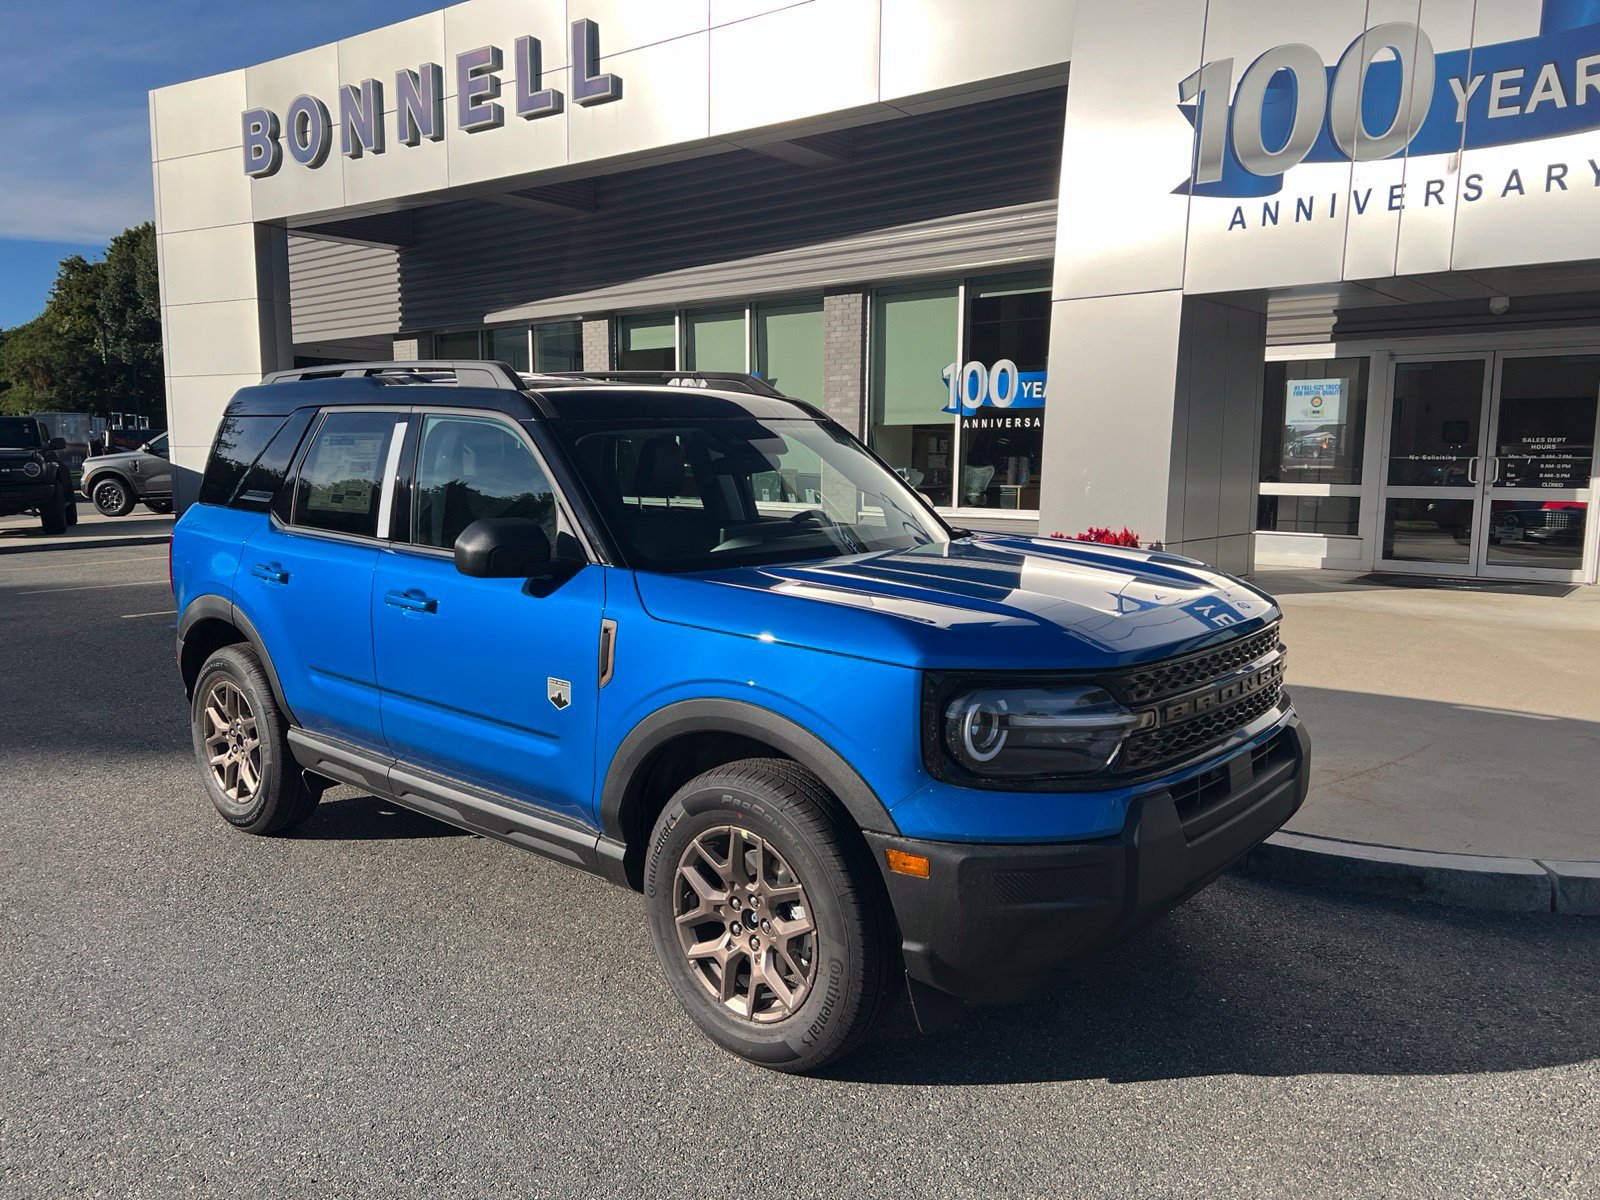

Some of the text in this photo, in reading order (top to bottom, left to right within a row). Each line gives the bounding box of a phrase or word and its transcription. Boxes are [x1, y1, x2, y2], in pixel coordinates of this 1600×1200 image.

[241, 18, 622, 179] BONNELL
[1178, 22, 1435, 184] 100
[942, 359, 1019, 409] 100
[962, 417, 1041, 428] ANNIVERSA
